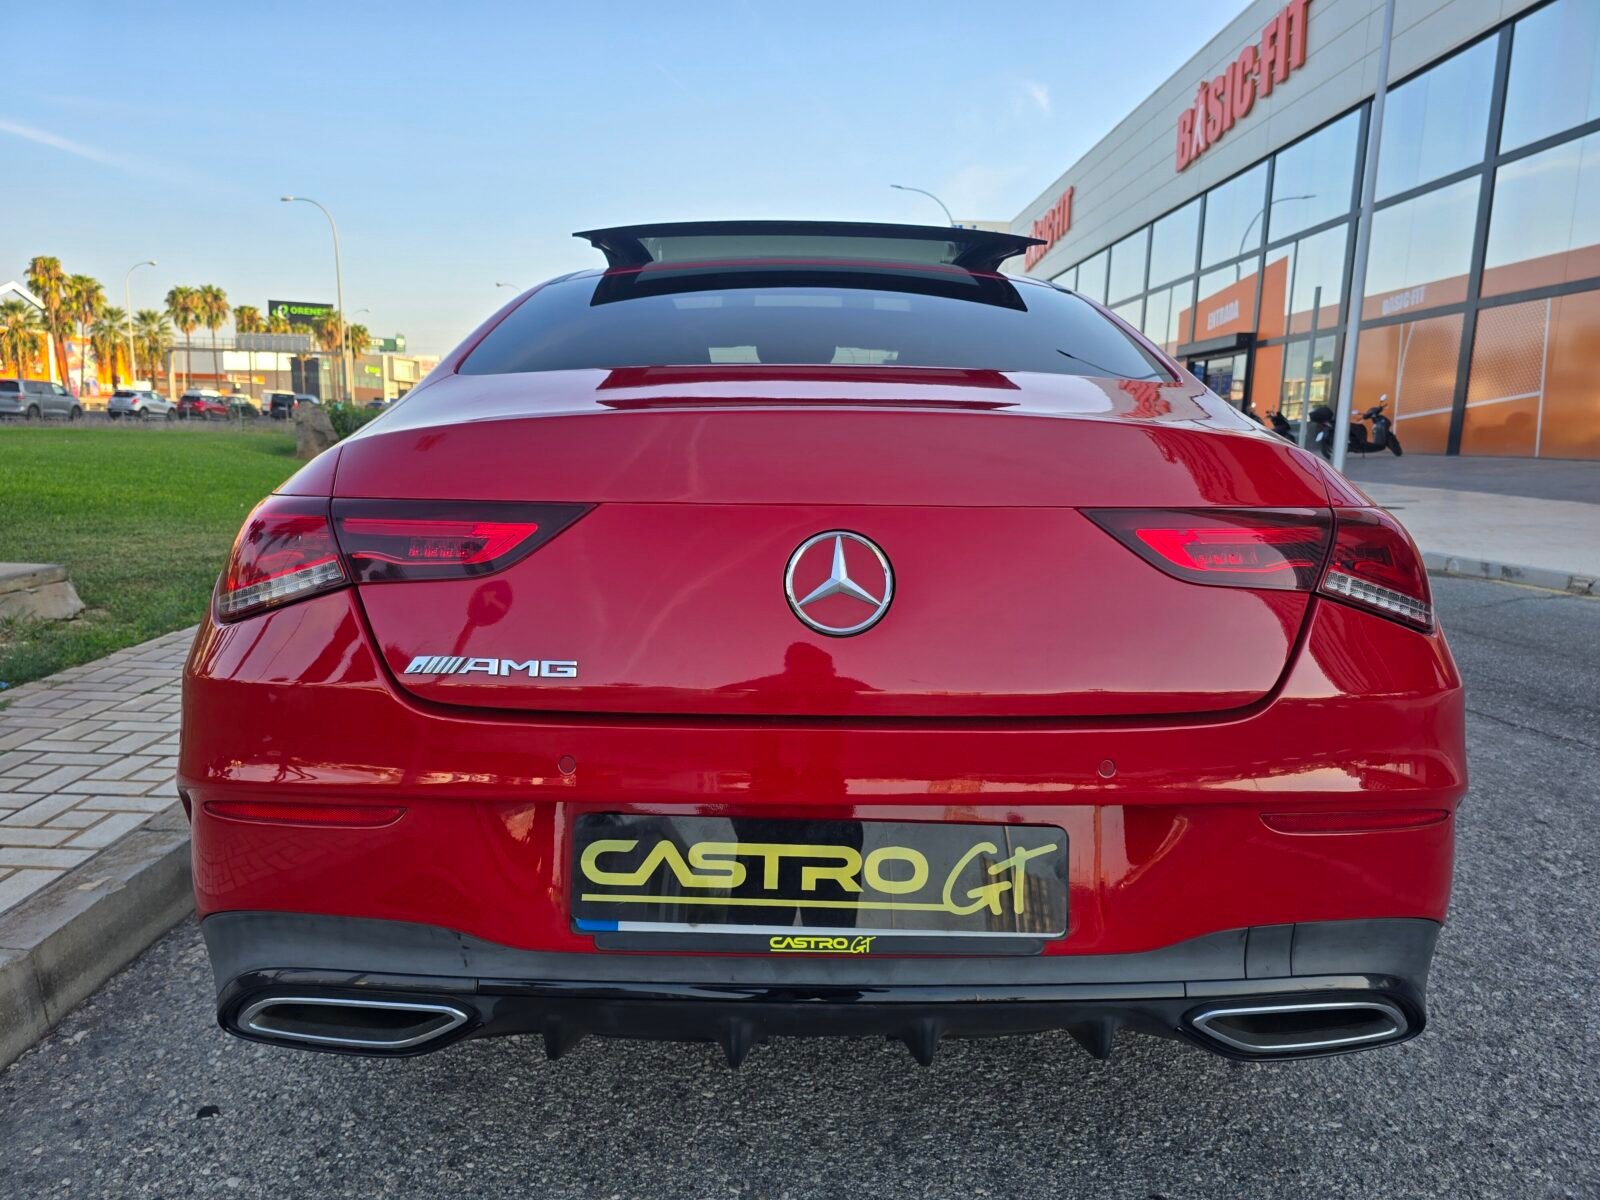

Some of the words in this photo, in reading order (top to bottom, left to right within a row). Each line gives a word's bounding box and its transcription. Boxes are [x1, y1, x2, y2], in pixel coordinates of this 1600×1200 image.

[458, 657, 578, 678] AMG
[580, 839, 930, 893] CASTRO
[942, 842, 1058, 916] GT
[769, 936, 849, 949] CASTRO
[850, 936, 877, 954] GT
